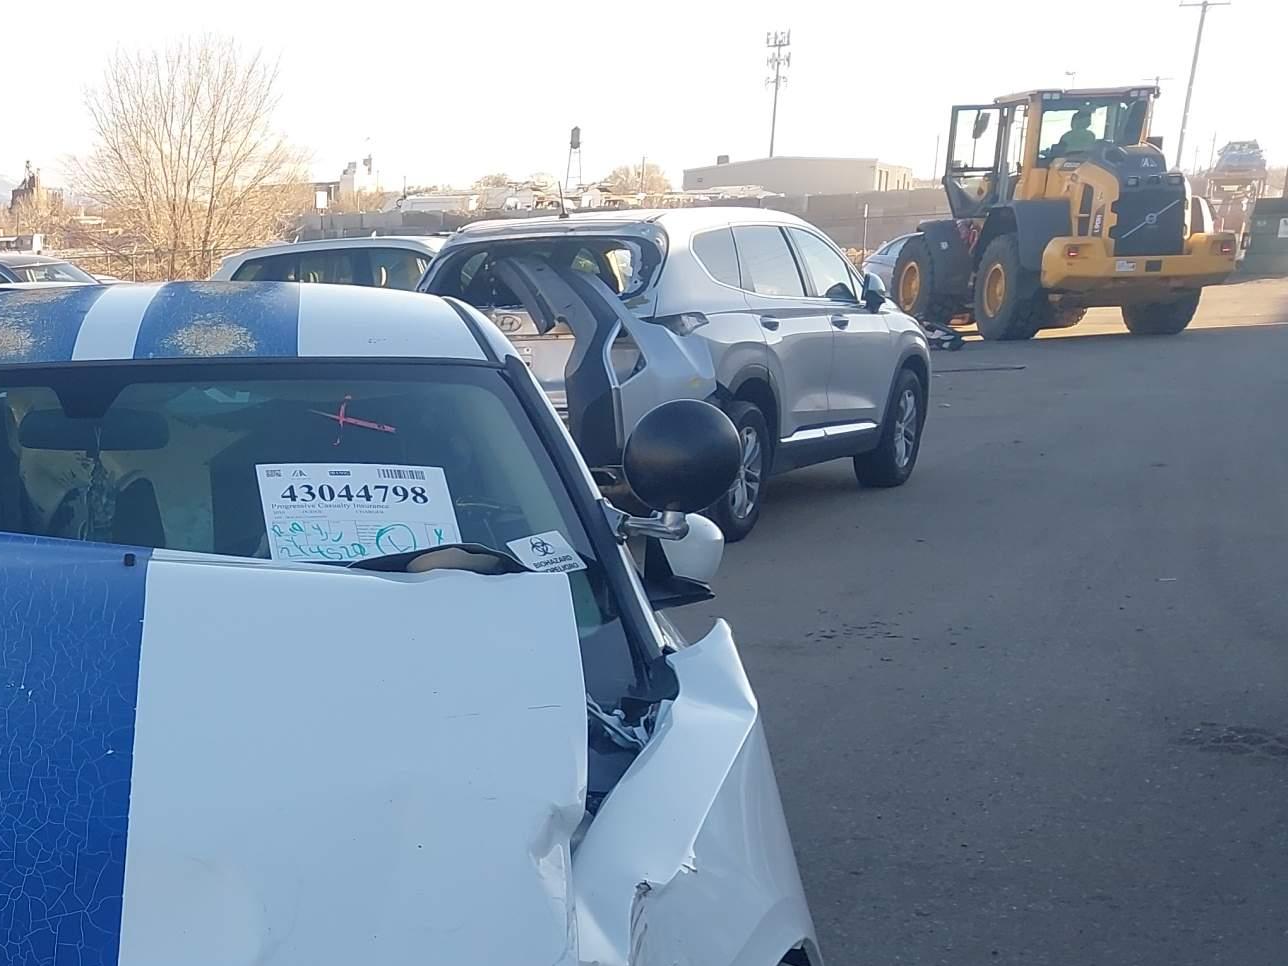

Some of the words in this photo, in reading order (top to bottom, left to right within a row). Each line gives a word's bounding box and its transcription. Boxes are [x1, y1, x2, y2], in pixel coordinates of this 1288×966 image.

[280, 483, 429, 505] 43044798
[271, 502, 316, 511] Progressive
[318, 502, 351, 511] Casualty
[533, 554, 573, 568] BIOHAZARD
